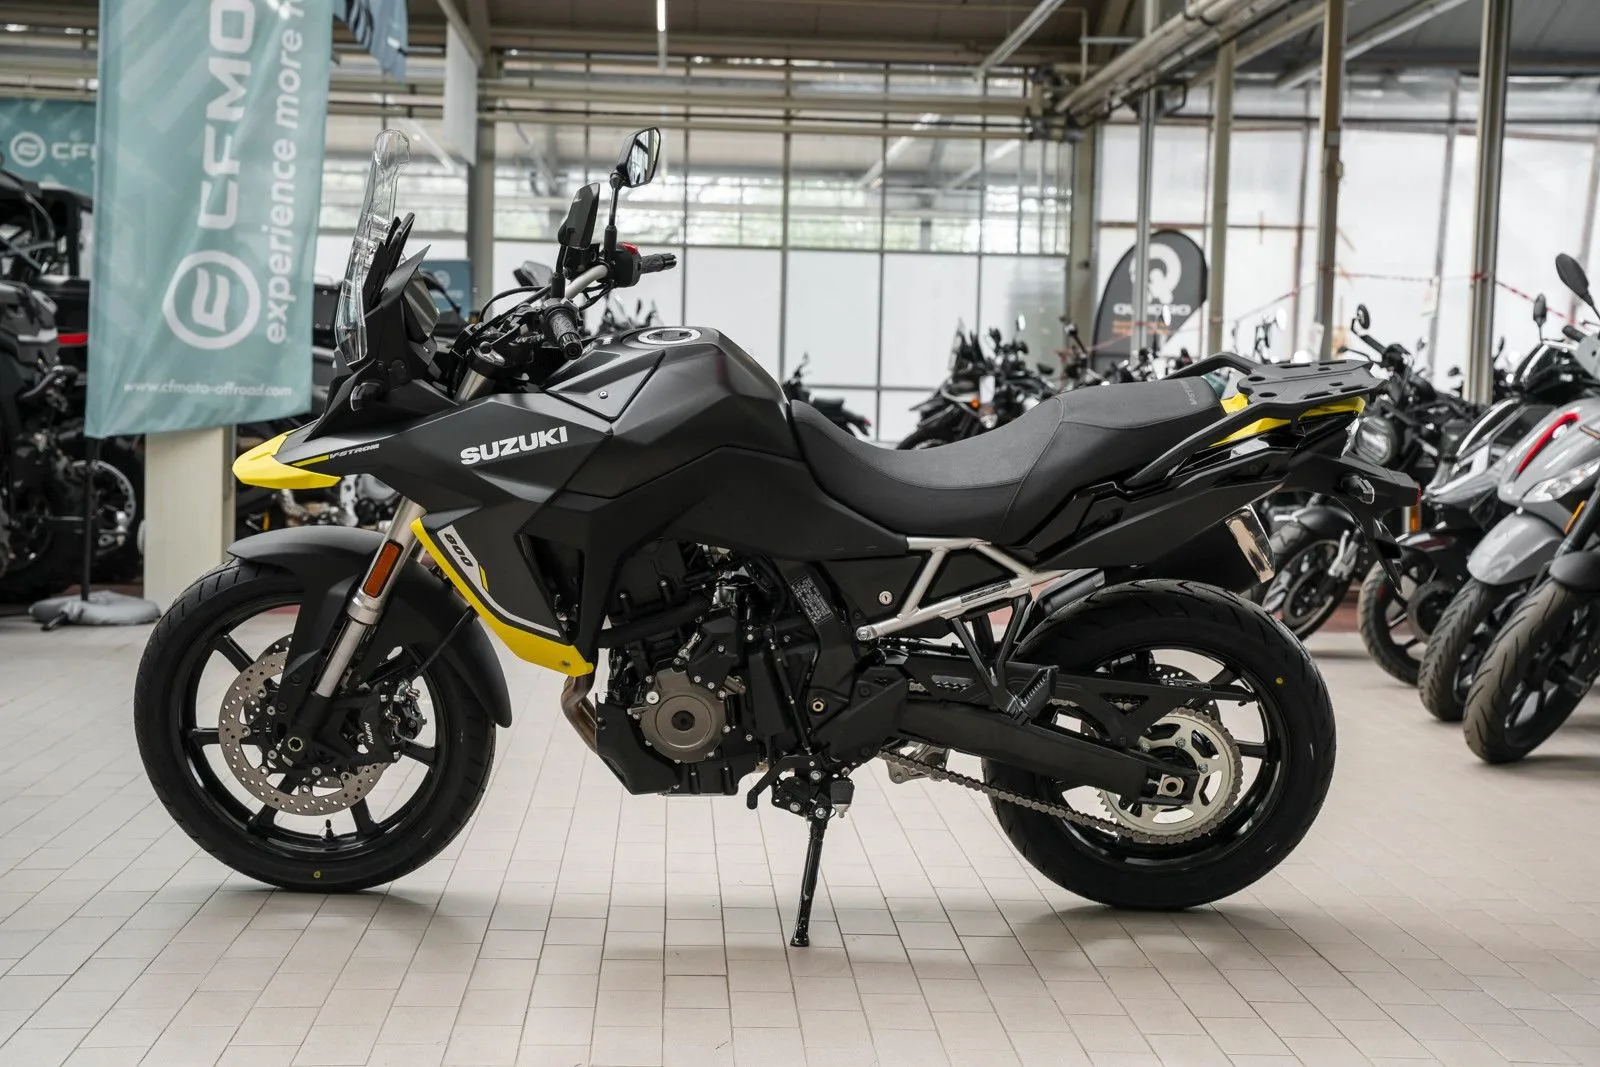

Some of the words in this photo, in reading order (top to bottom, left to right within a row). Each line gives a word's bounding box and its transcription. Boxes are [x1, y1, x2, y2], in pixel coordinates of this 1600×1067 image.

[275, 29, 303, 130] more
[262, 140, 297, 345] experience
[460, 425, 569, 465] SUZUKI
[444, 533, 474, 567] 800
